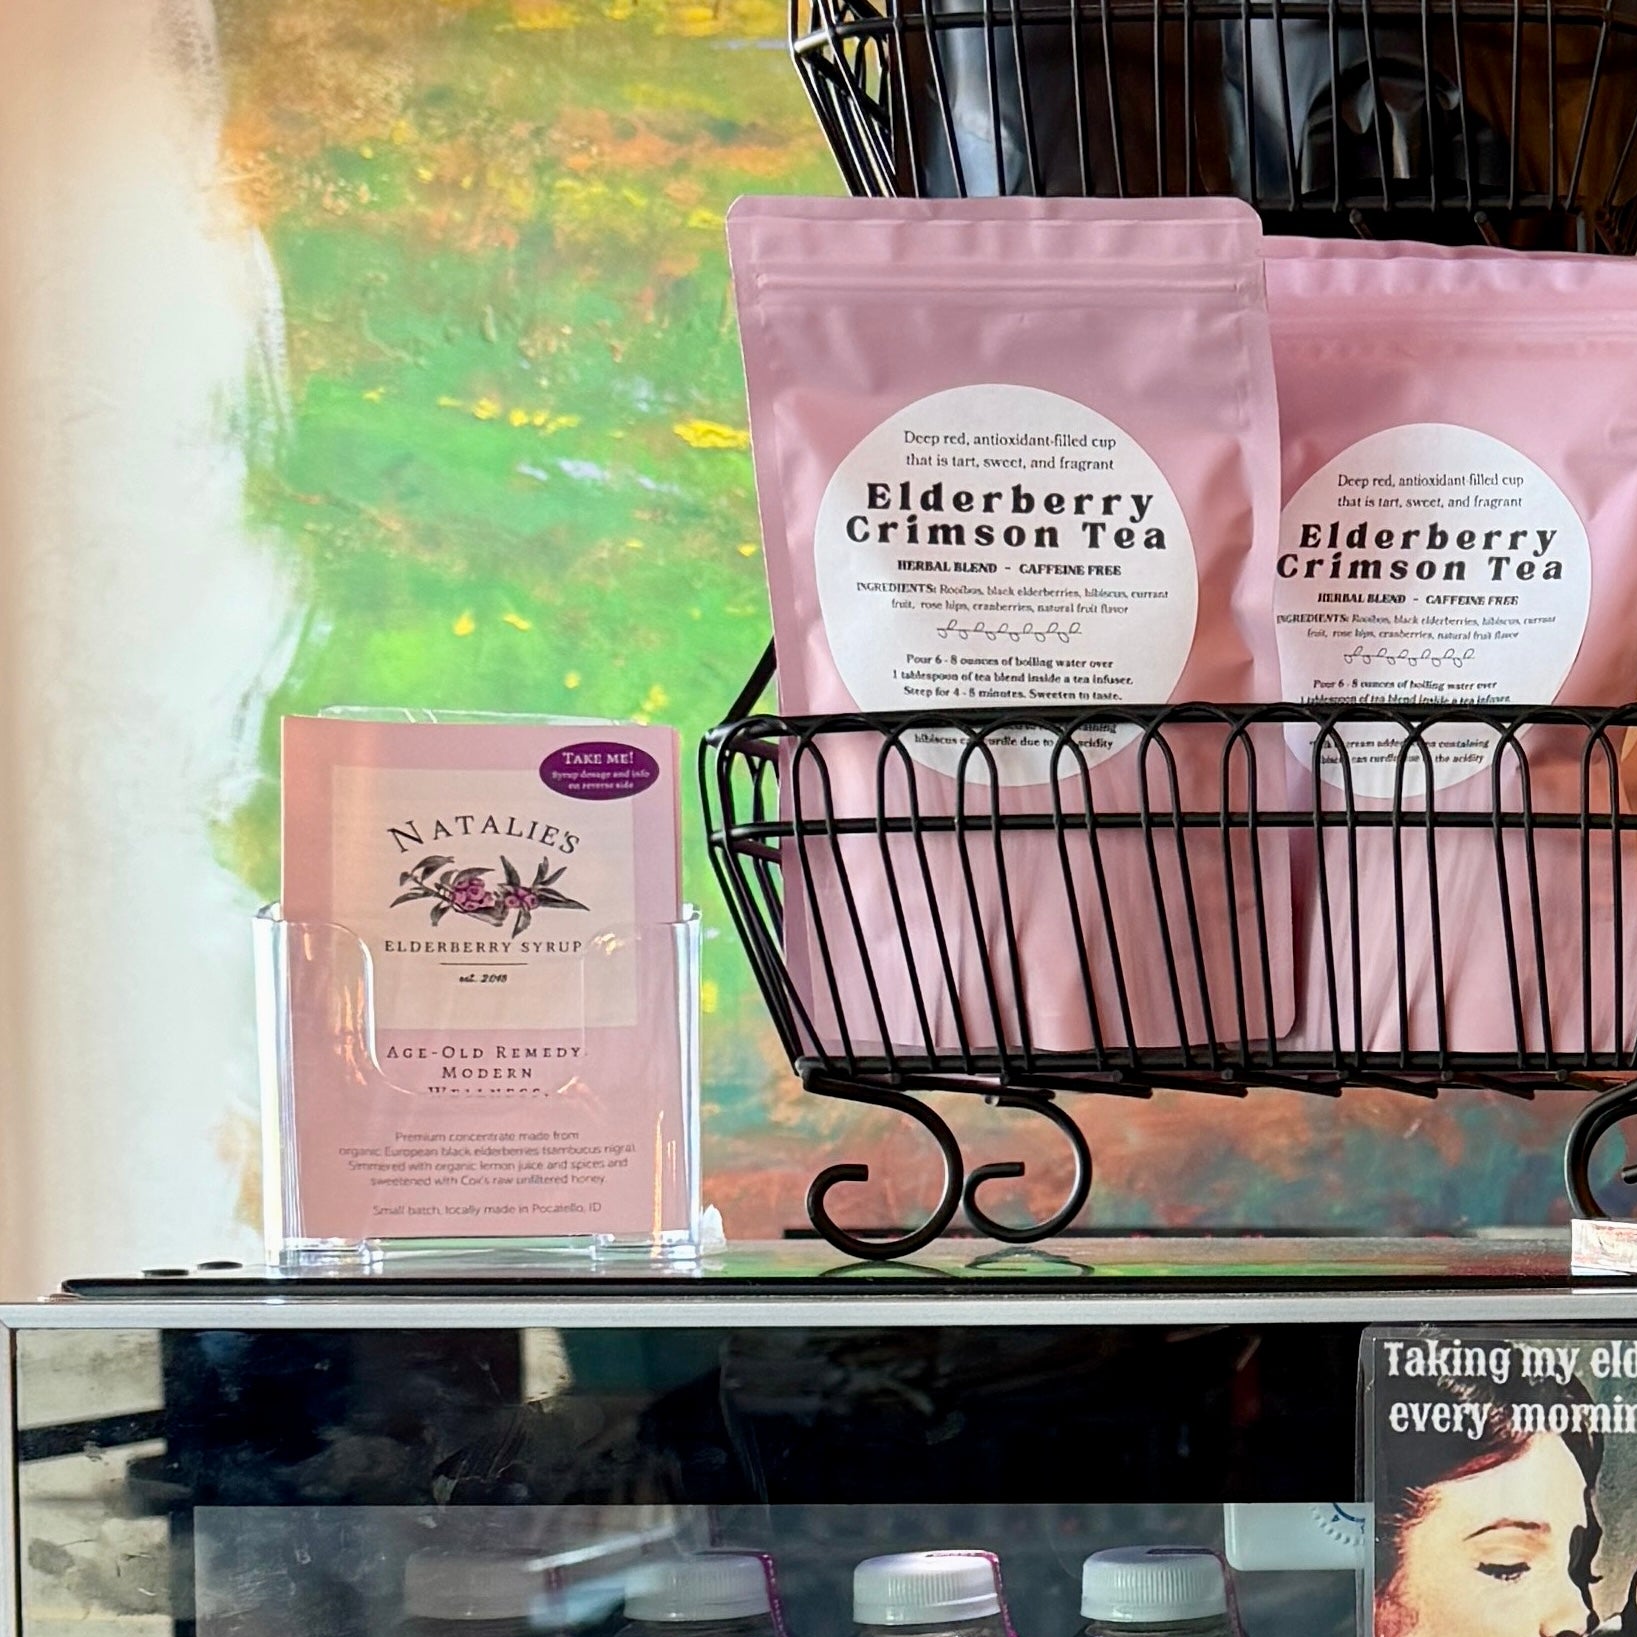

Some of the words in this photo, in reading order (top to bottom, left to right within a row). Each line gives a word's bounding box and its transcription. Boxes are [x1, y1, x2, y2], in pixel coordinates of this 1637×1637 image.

[904, 431, 940, 446] Deep
[944, 432, 970, 447] red,
[973, 434, 1087, 448] antioxidant-filled
[1091, 437, 1116, 450] cup
[906, 454, 932, 466] that
[937, 455, 948, 467] is
[952, 455, 979, 469] tart,
[983, 457, 1026, 469] sweet,
[1030, 457, 1055, 469] and
[1059, 457, 1114, 472] fragrant
[1338, 475, 1368, 488] Deep
[1372, 475, 1395, 487] red,
[1502, 476, 1523, 488] cup
[867, 481, 1153, 523] Elderberry
[1338, 496, 1361, 507] that
[1365, 497, 1375, 507] is
[1378, 497, 1402, 508] tart,
[1405, 498, 1443, 508] sweet,
[1448, 497, 1470, 507] and
[1474, 497, 1522, 509] fragrant
[846, 514, 1059, 548] Crimson
[1082, 522, 1167, 550] Tea
[1299, 521, 1557, 557] Elderberry
[897, 560, 950, 573] HERBAL
[954, 561, 997, 574] BLEND
[1020, 563, 1084, 576] CAFFEINE
[1088, 565, 1121, 576] FREE
[1277, 552, 1466, 581] Crimson
[1488, 556, 1563, 581] Tea
[987, 585, 1014, 596] black
[1318, 593, 1364, 603] HERBAL
[1367, 594, 1406, 604] BLEND
[1426, 595, 1484, 605] CAFFEINE
[1488, 596, 1518, 606] FREE
[1037, 603, 1074, 613] natural
[1077, 603, 1098, 614] fruit
[906, 654, 931, 665] Pour
[934, 655, 941, 665] 6
[960, 657, 998, 666] ounces
[1001, 657, 1012, 666] of
[1015, 656, 1053, 669] boiling
[1056, 658, 1086, 668] water
[1089, 659, 1113, 669] over
[387, 815, 579, 854] NATALIE'S
[385, 940, 511, 953] ELDERBERRY
[521, 941, 582, 953] SYRUP
[1384, 1338, 1510, 1383] Taking
[1521, 1343, 1579, 1385] my
[1389, 1403, 1489, 1439] every
